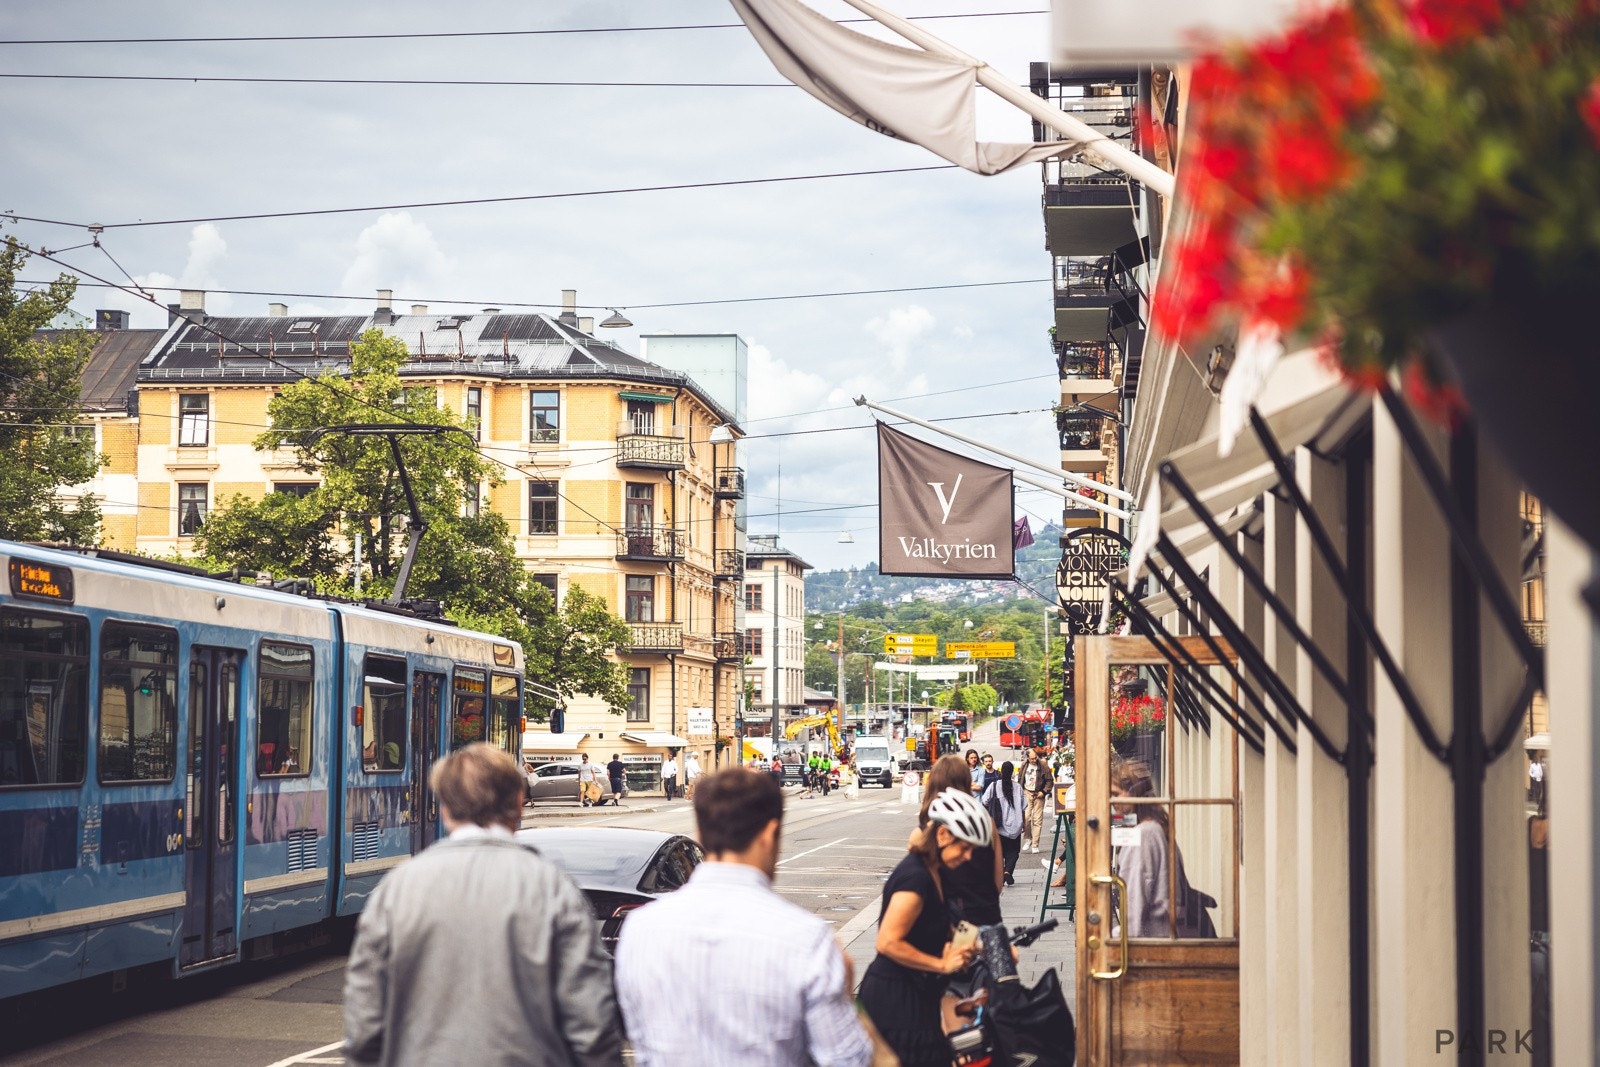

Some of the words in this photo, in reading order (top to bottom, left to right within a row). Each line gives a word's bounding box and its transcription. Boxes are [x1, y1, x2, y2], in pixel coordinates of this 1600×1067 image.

[897, 536, 997, 564] Valkyrien
[1057, 556, 1128, 571] MONIKER
[1056, 571, 1117, 586] MONIK
